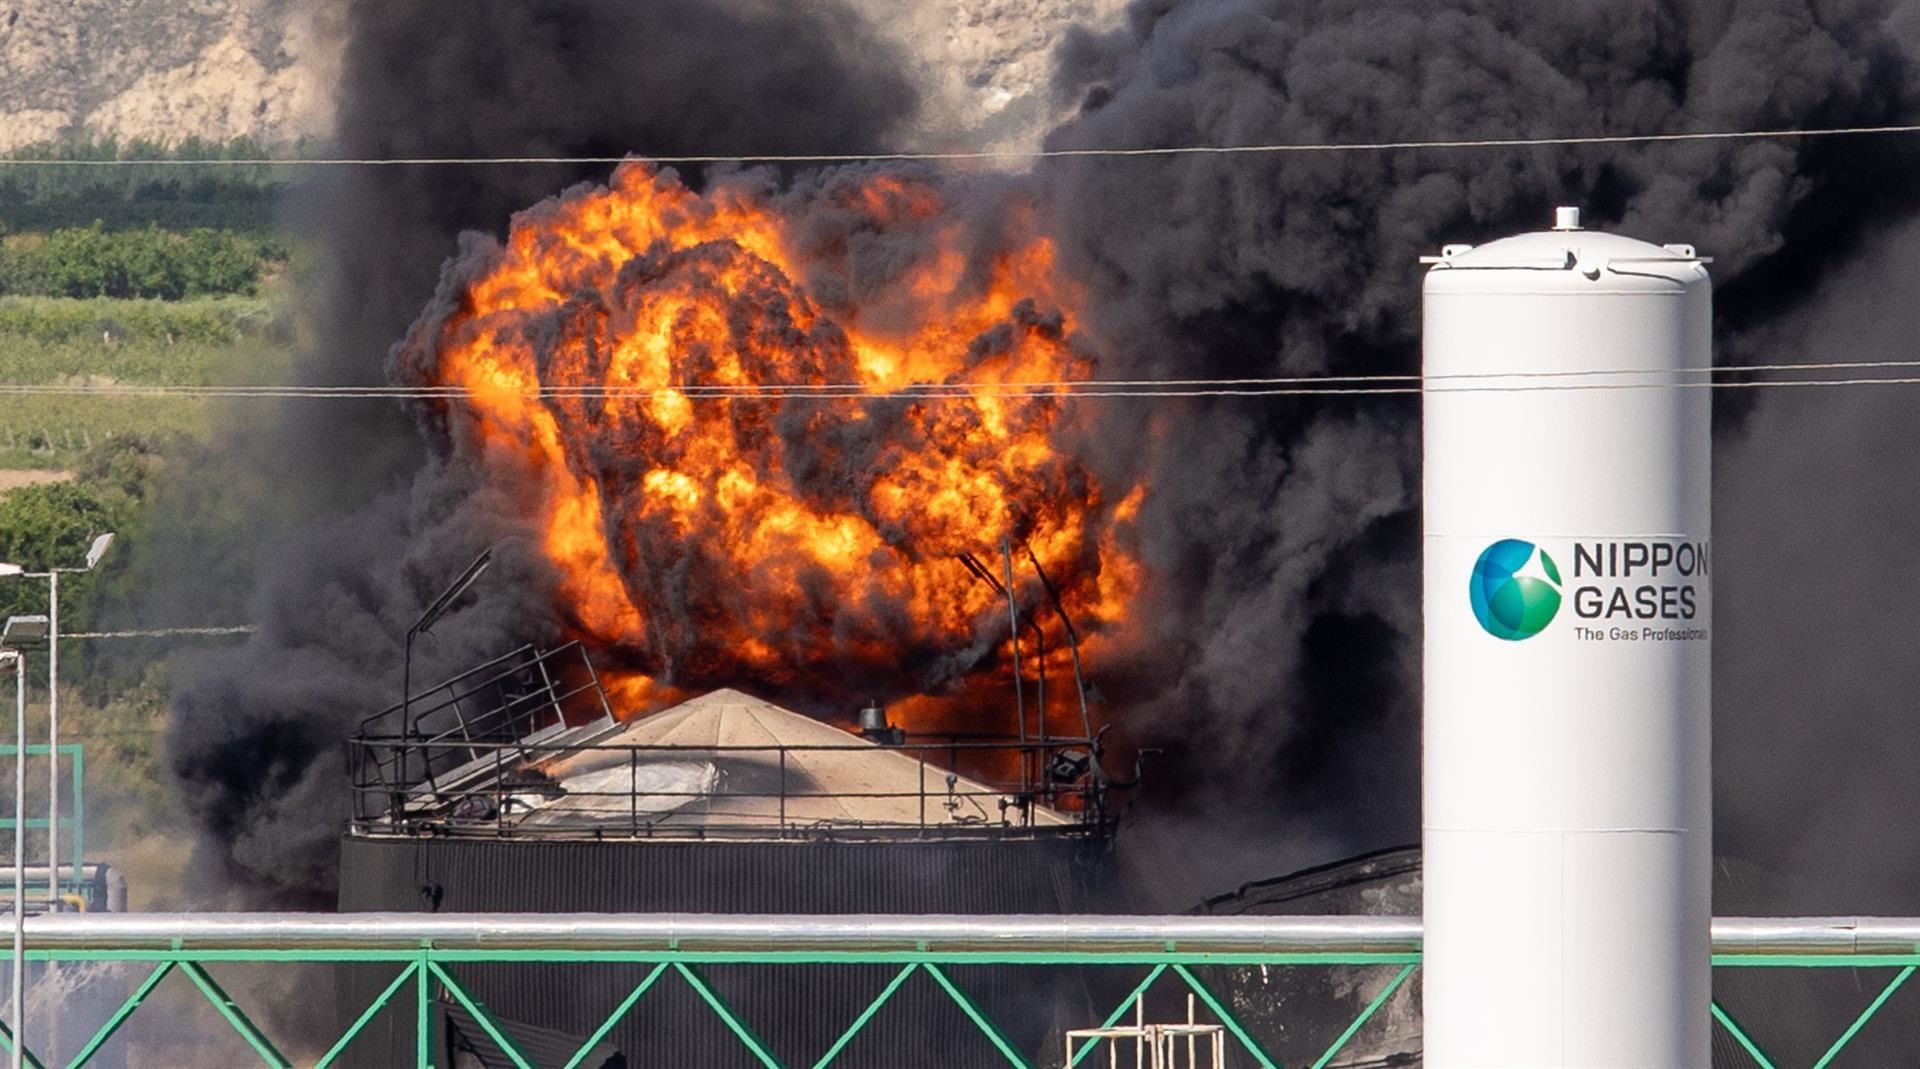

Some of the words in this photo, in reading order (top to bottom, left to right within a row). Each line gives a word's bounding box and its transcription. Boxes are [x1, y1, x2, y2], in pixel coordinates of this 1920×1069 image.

[1574, 543, 1708, 577] NIPPON
[1574, 586, 1696, 619] GASES
[1574, 627, 1604, 641] The
[1609, 627, 1638, 641] Gas
